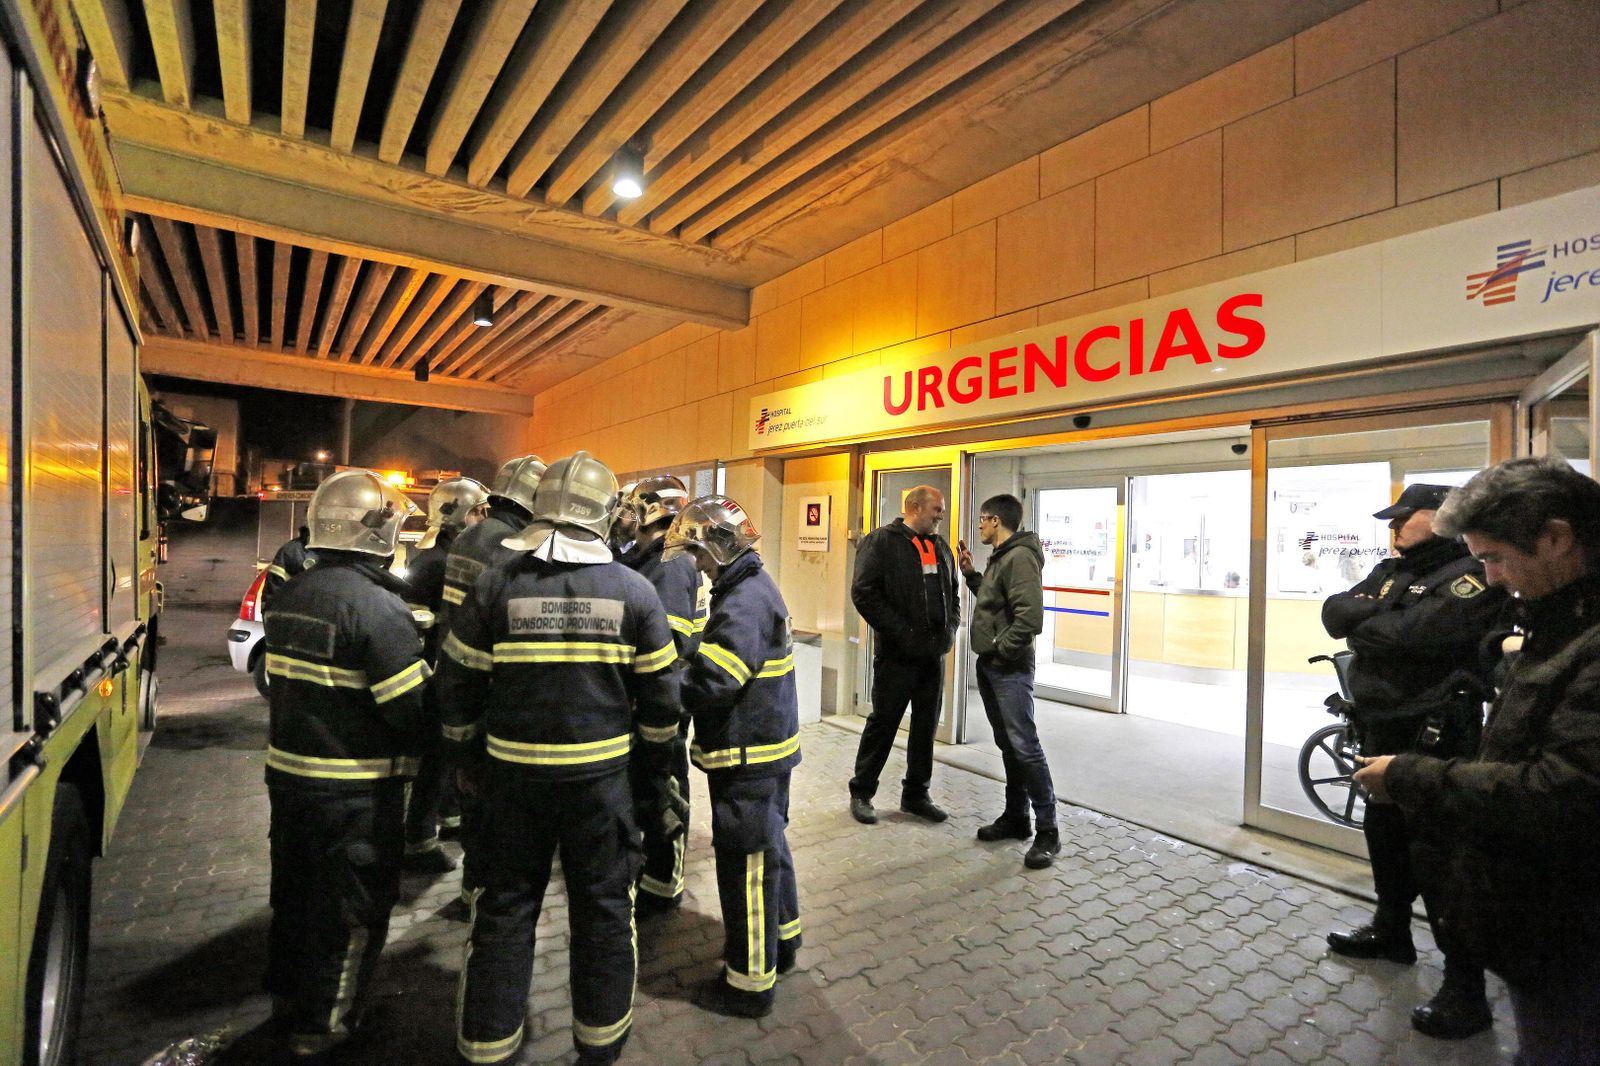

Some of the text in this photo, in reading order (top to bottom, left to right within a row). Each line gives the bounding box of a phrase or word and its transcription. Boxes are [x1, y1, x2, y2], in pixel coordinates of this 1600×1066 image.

[883, 293, 1266, 416] URGENCIAS
[769, 408, 792, 419] HOSPITAL
[767, 422, 783, 437] jerez
[783, 416, 804, 433] puerta
[1318, 546, 1388, 558] jerez puerta
[541, 601, 592, 614] BOMBEROS
[511, 617, 618, 632] CONSORCIO PROVINCIAL
